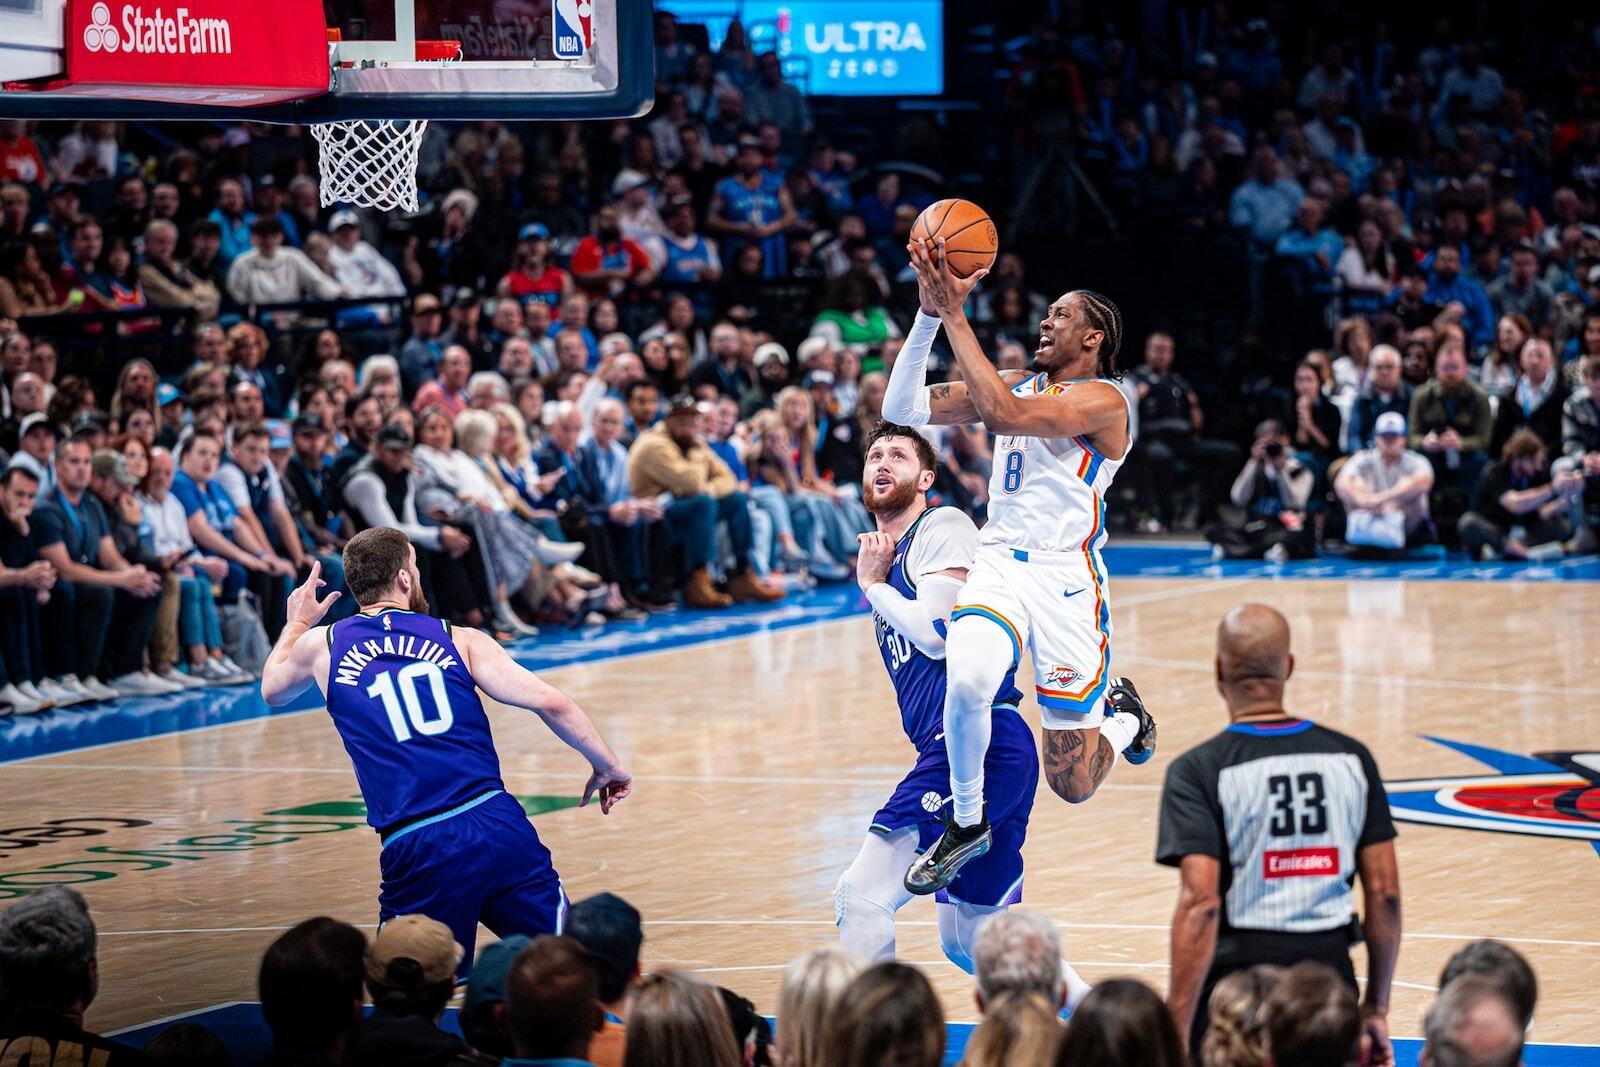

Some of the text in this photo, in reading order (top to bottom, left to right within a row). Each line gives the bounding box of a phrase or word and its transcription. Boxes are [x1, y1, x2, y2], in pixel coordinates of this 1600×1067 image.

[559, 36, 578, 53] NBA
[804, 21, 926, 53] ULTRA
[1003, 449, 1025, 496] 8
[335, 635, 458, 687] MYKHAILIUK
[886, 629, 912, 670] 30
[366, 660, 454, 743] 10
[1269, 772, 1328, 837] 33
[0, 819, 369, 900] payco
[1269, 854, 1333, 873] Emirates
